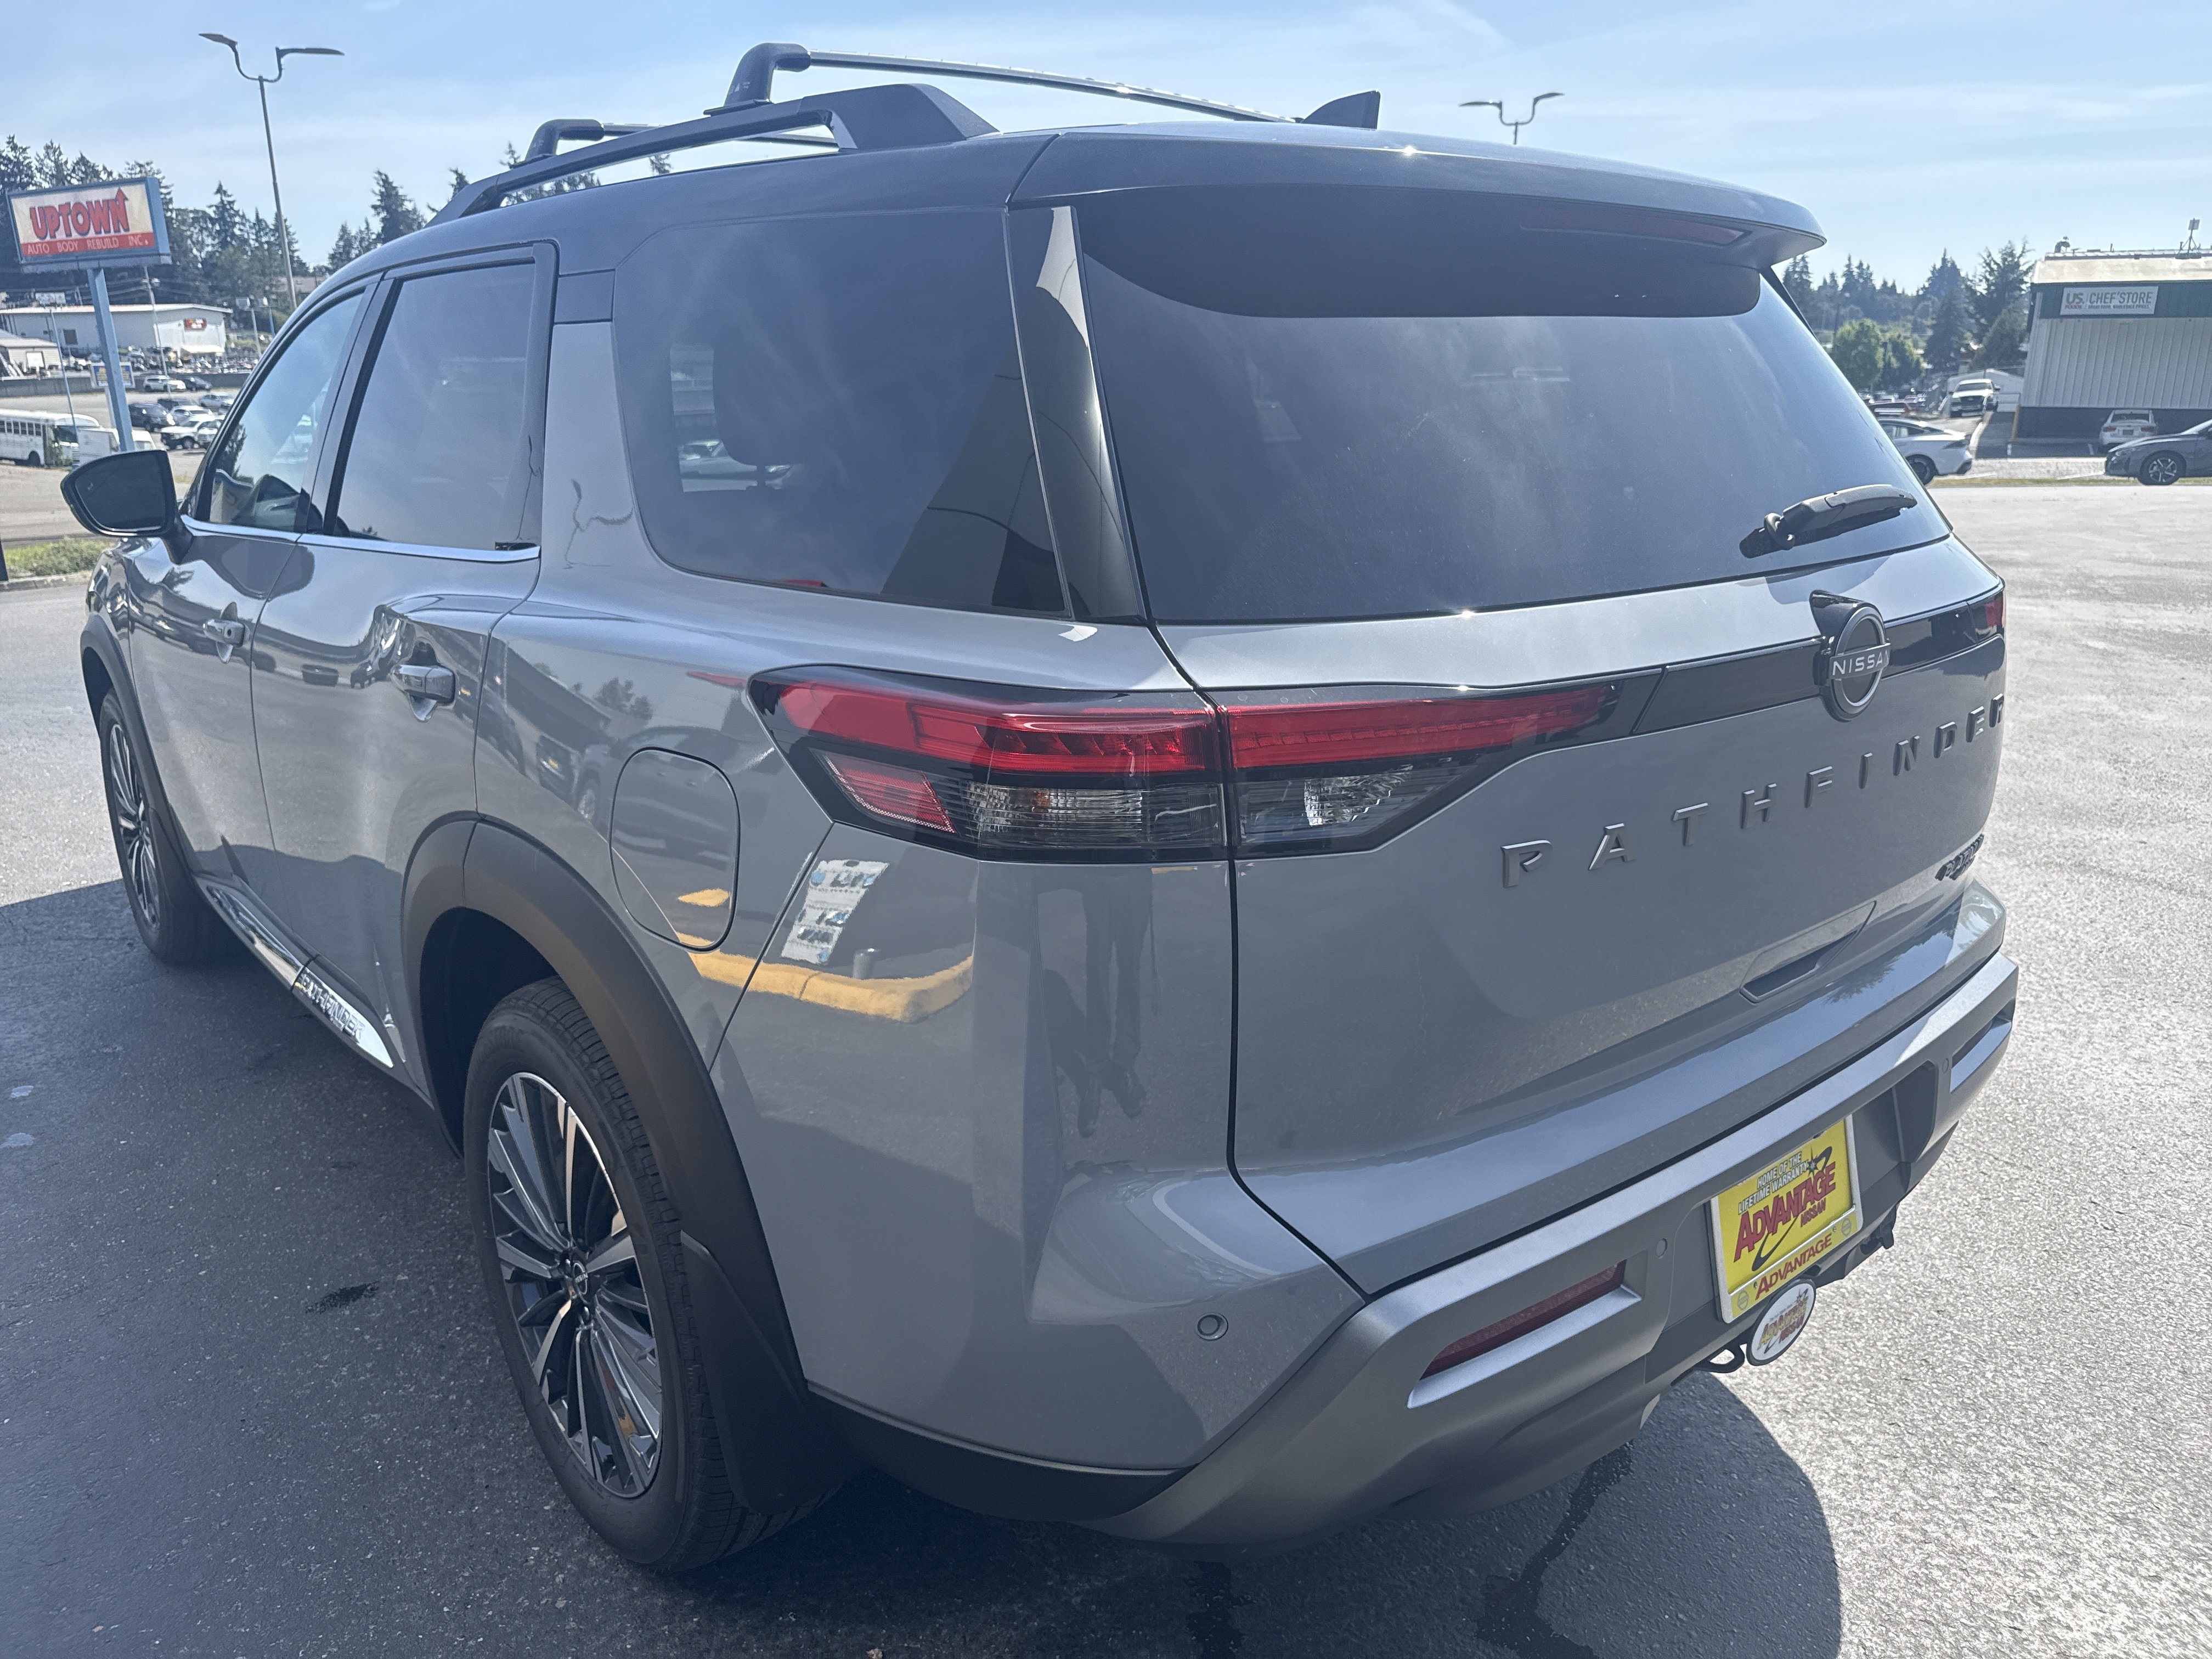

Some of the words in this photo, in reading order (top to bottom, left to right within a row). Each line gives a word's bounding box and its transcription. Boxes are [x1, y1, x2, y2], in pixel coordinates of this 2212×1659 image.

[30, 187, 129, 240] UPTOWN
[28, 243, 49, 255] AUTO
[57, 241, 78, 253] BODY
[87, 237, 119, 251] REBUILD
[129, 234, 149, 246] INC.
[2089, 291, 2153, 304] CHEF'STORE
[1832, 648, 1889, 676] NISSAN
[1502, 693, 2005, 888] PATHFINDER
[1738, 1183, 1771, 1215] LIFETIME
[1770, 1159, 1809, 1193] WARRANTY
[1757, 1166, 1777, 1189] HOME
[1778, 1160, 1788, 1176] OF
[1789, 1151, 1802, 1170] THE
[1734, 1161, 1836, 1263] ADVANTAGE
[1755, 1233, 1832, 1300] ADVANTAGE
